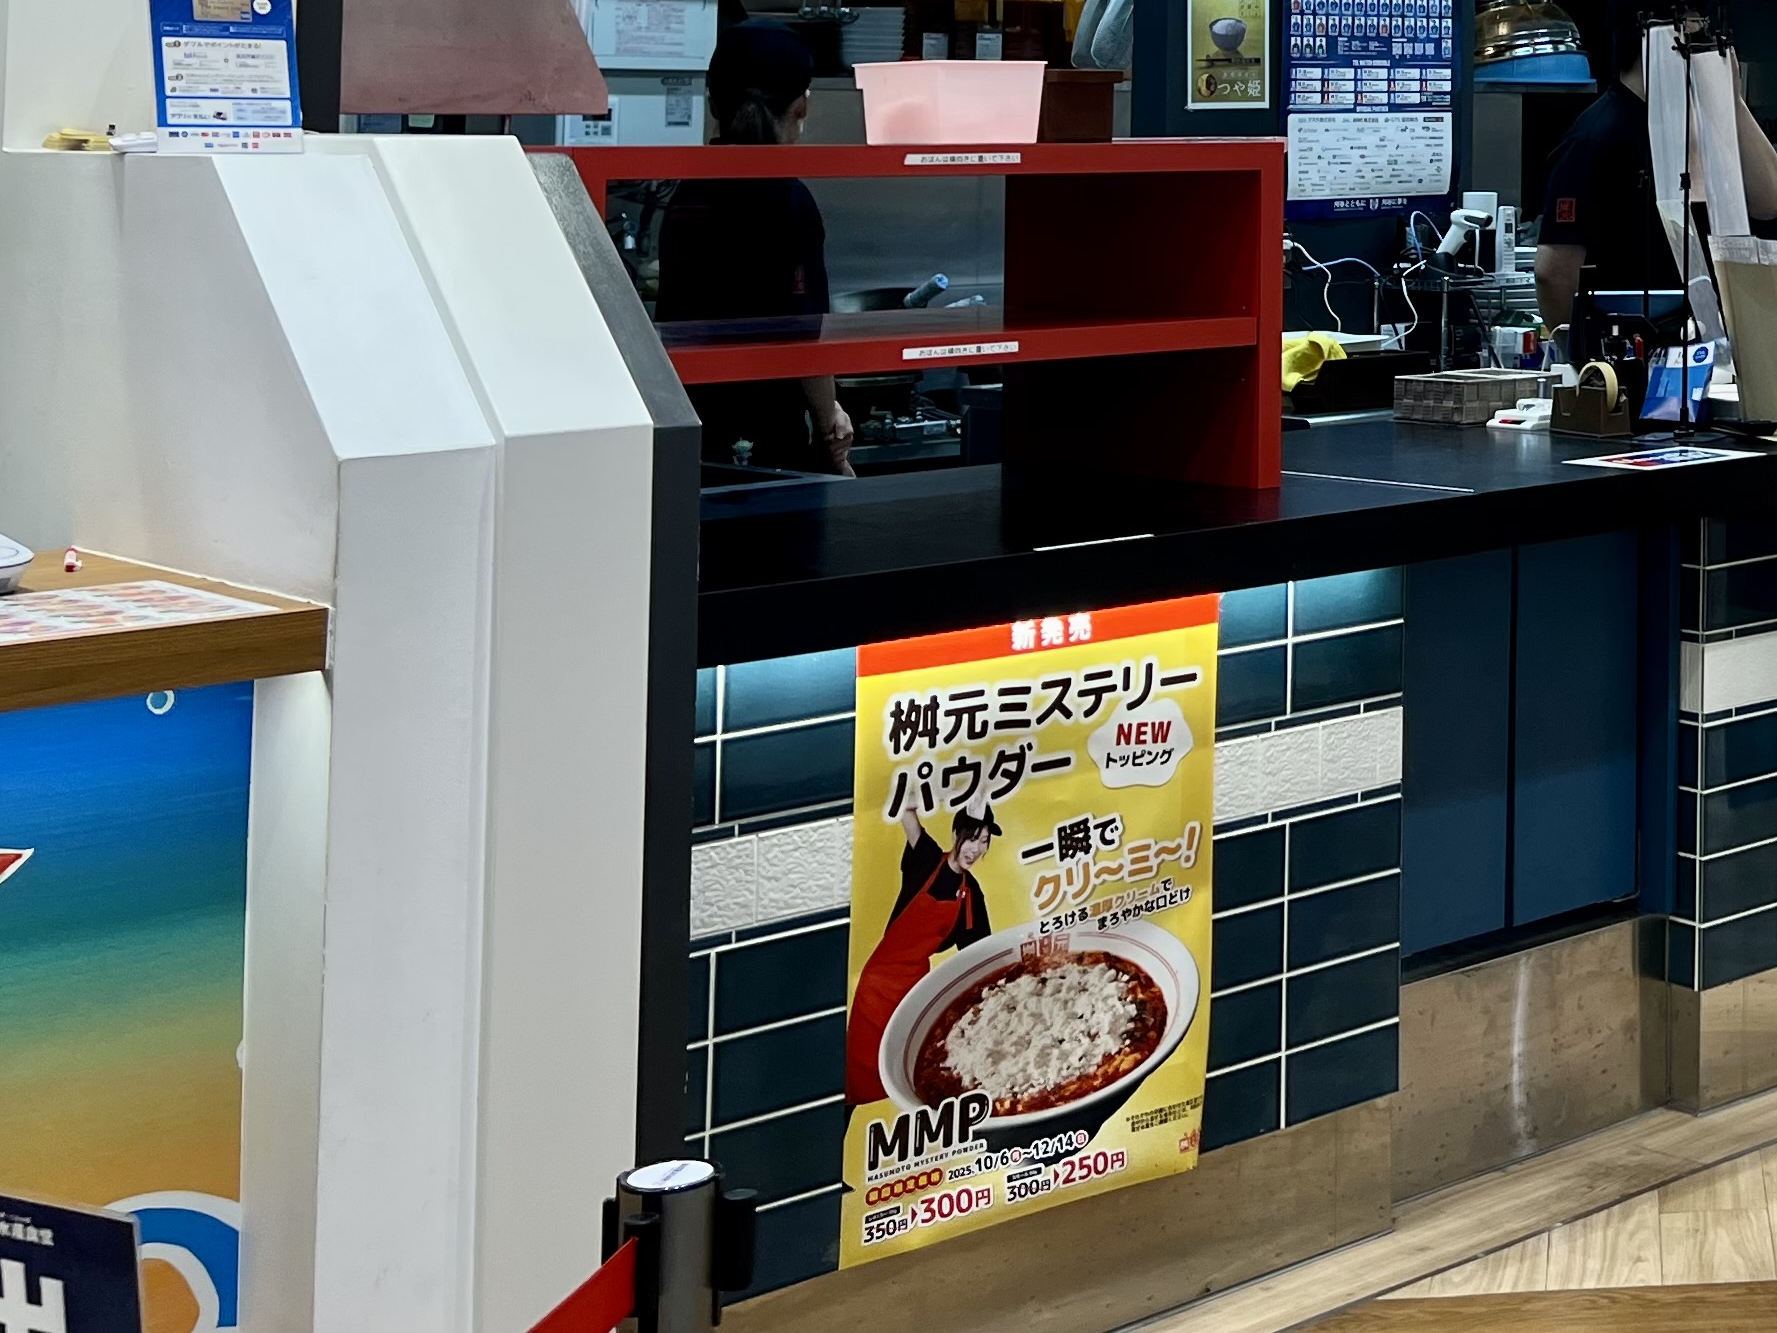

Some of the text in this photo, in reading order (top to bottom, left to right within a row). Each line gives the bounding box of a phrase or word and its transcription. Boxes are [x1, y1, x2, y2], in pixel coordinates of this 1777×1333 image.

[1217, 80, 1262, 97] つや姫
[1010, 612, 1093, 651] 新発売
[889, 661, 1198, 755] 桝元ミステリー
[1115, 720, 1172, 747] NEW
[887, 742, 1072, 818] パウダー
[1105, 747, 1175, 769] トッピング
[1021, 816, 1120, 862] 一瞬で
[1039, 878, 1173, 935] とろける濃厚クリームで
[1096, 886, 1192, 931] まろやかな口どけ
[867, 1093, 992, 1171] MMP
[867, 1141, 985, 1182] MASUMOTO MYSTERY POWDER
[863, 1150, 1126, 1245] 350円 300円 300円 250円
